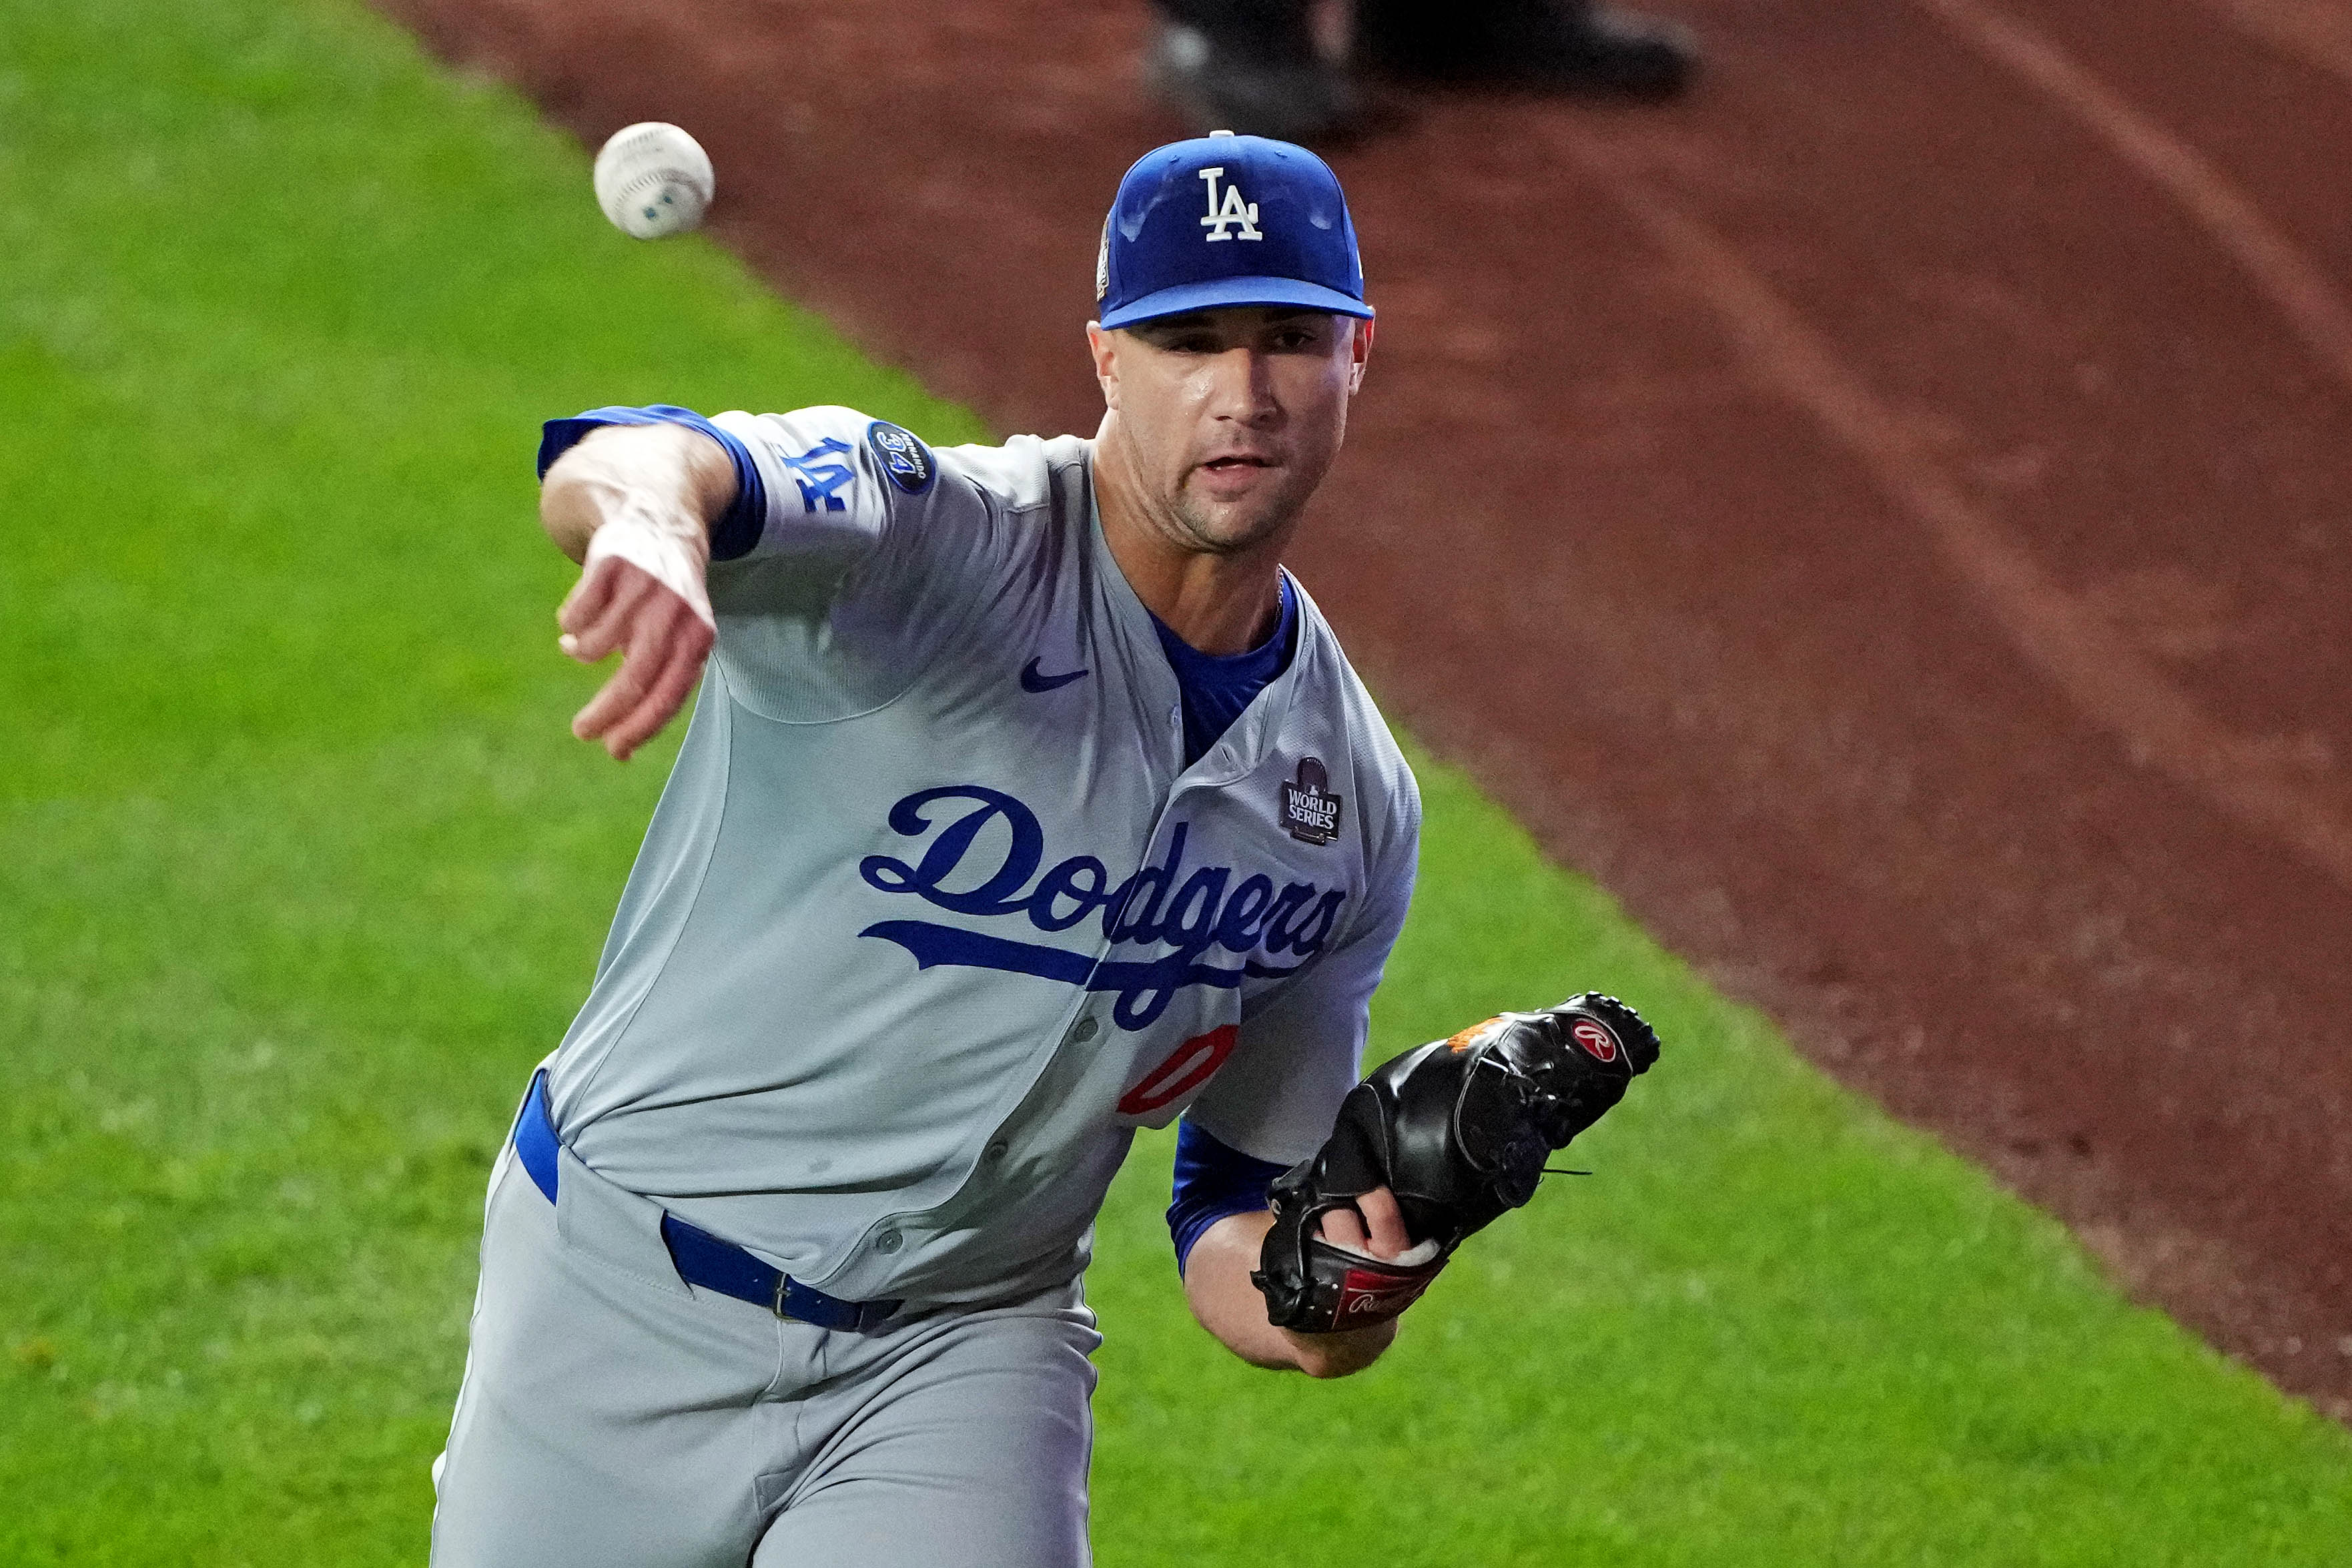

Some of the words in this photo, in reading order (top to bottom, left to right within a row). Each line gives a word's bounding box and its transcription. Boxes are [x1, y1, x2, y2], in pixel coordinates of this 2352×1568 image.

[1199, 167, 1262, 242] LA
[876, 431, 916, 474] 34
[1288, 788, 1337, 815] WORLD
[1288, 804, 1334, 829] SERIES
[857, 785, 1346, 1032] Dodgers
[1117, 1024, 1240, 1114] 0
